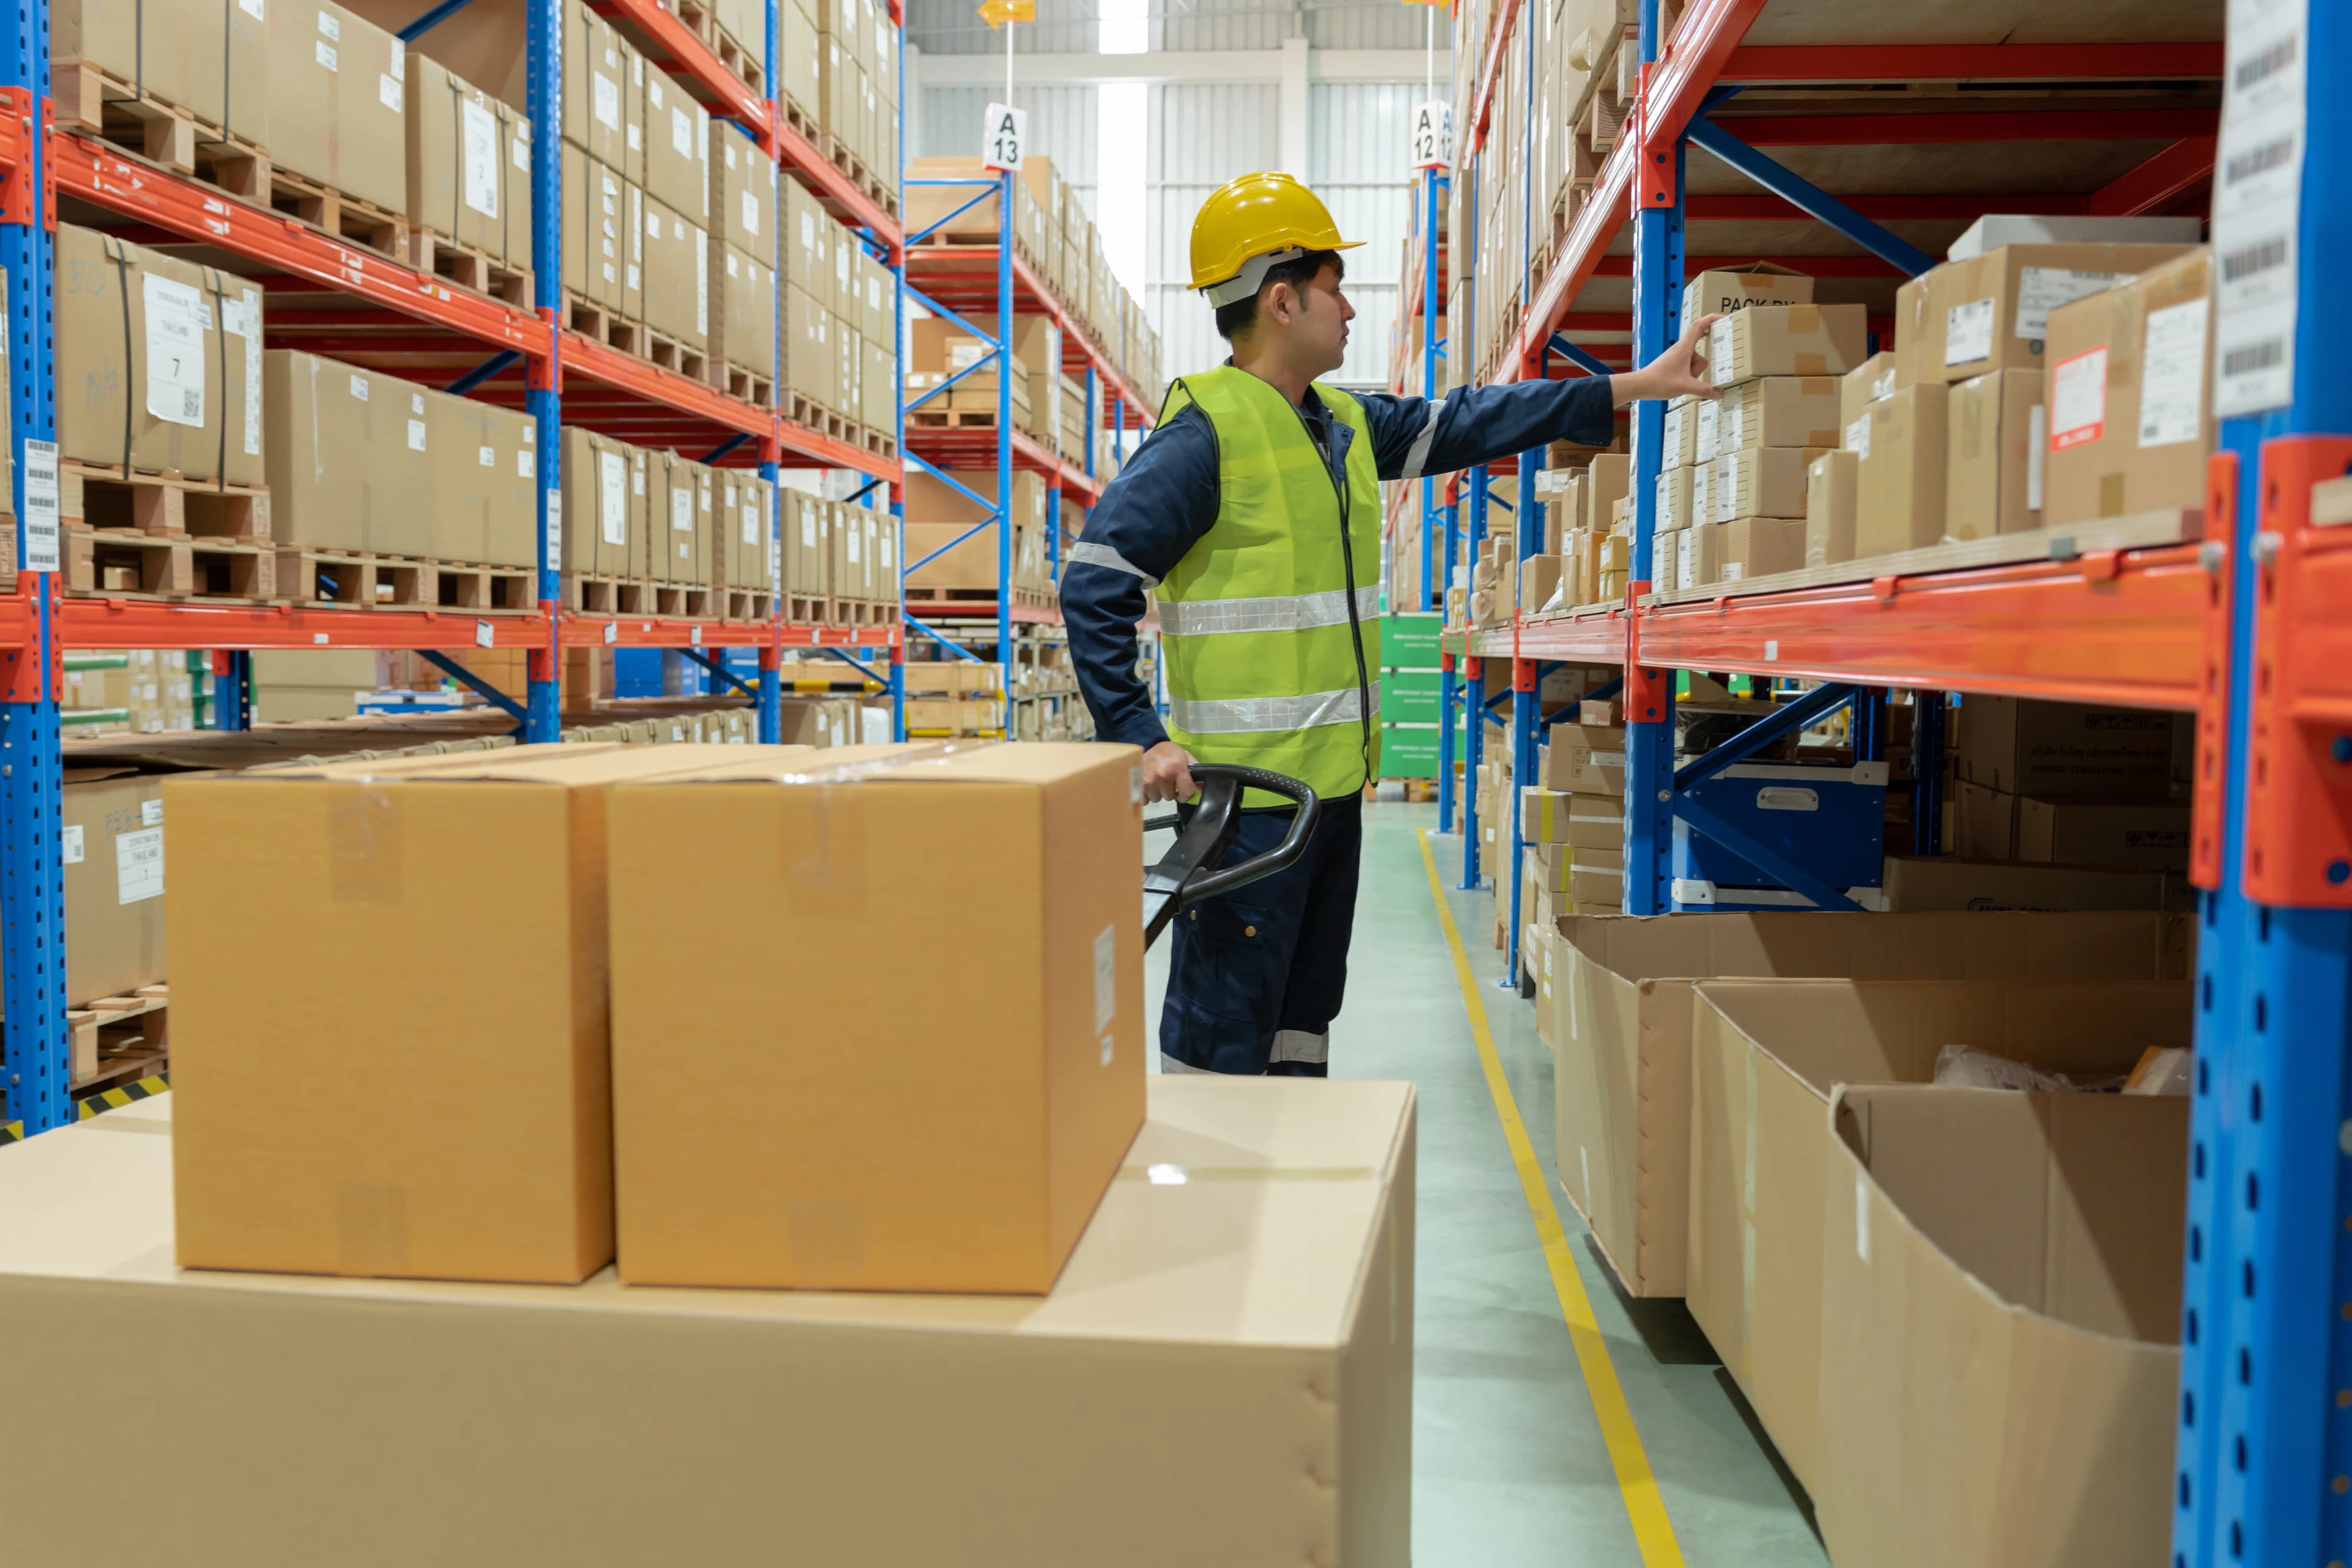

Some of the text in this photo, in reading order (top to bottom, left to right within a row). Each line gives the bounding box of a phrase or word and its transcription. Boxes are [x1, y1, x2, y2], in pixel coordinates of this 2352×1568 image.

[999, 113, 1016, 136] A
[1418, 109, 1431, 132] A
[995, 138, 1017, 163] 13
[1415, 135, 1433, 160] 12
[172, 357, 180, 377] 7
